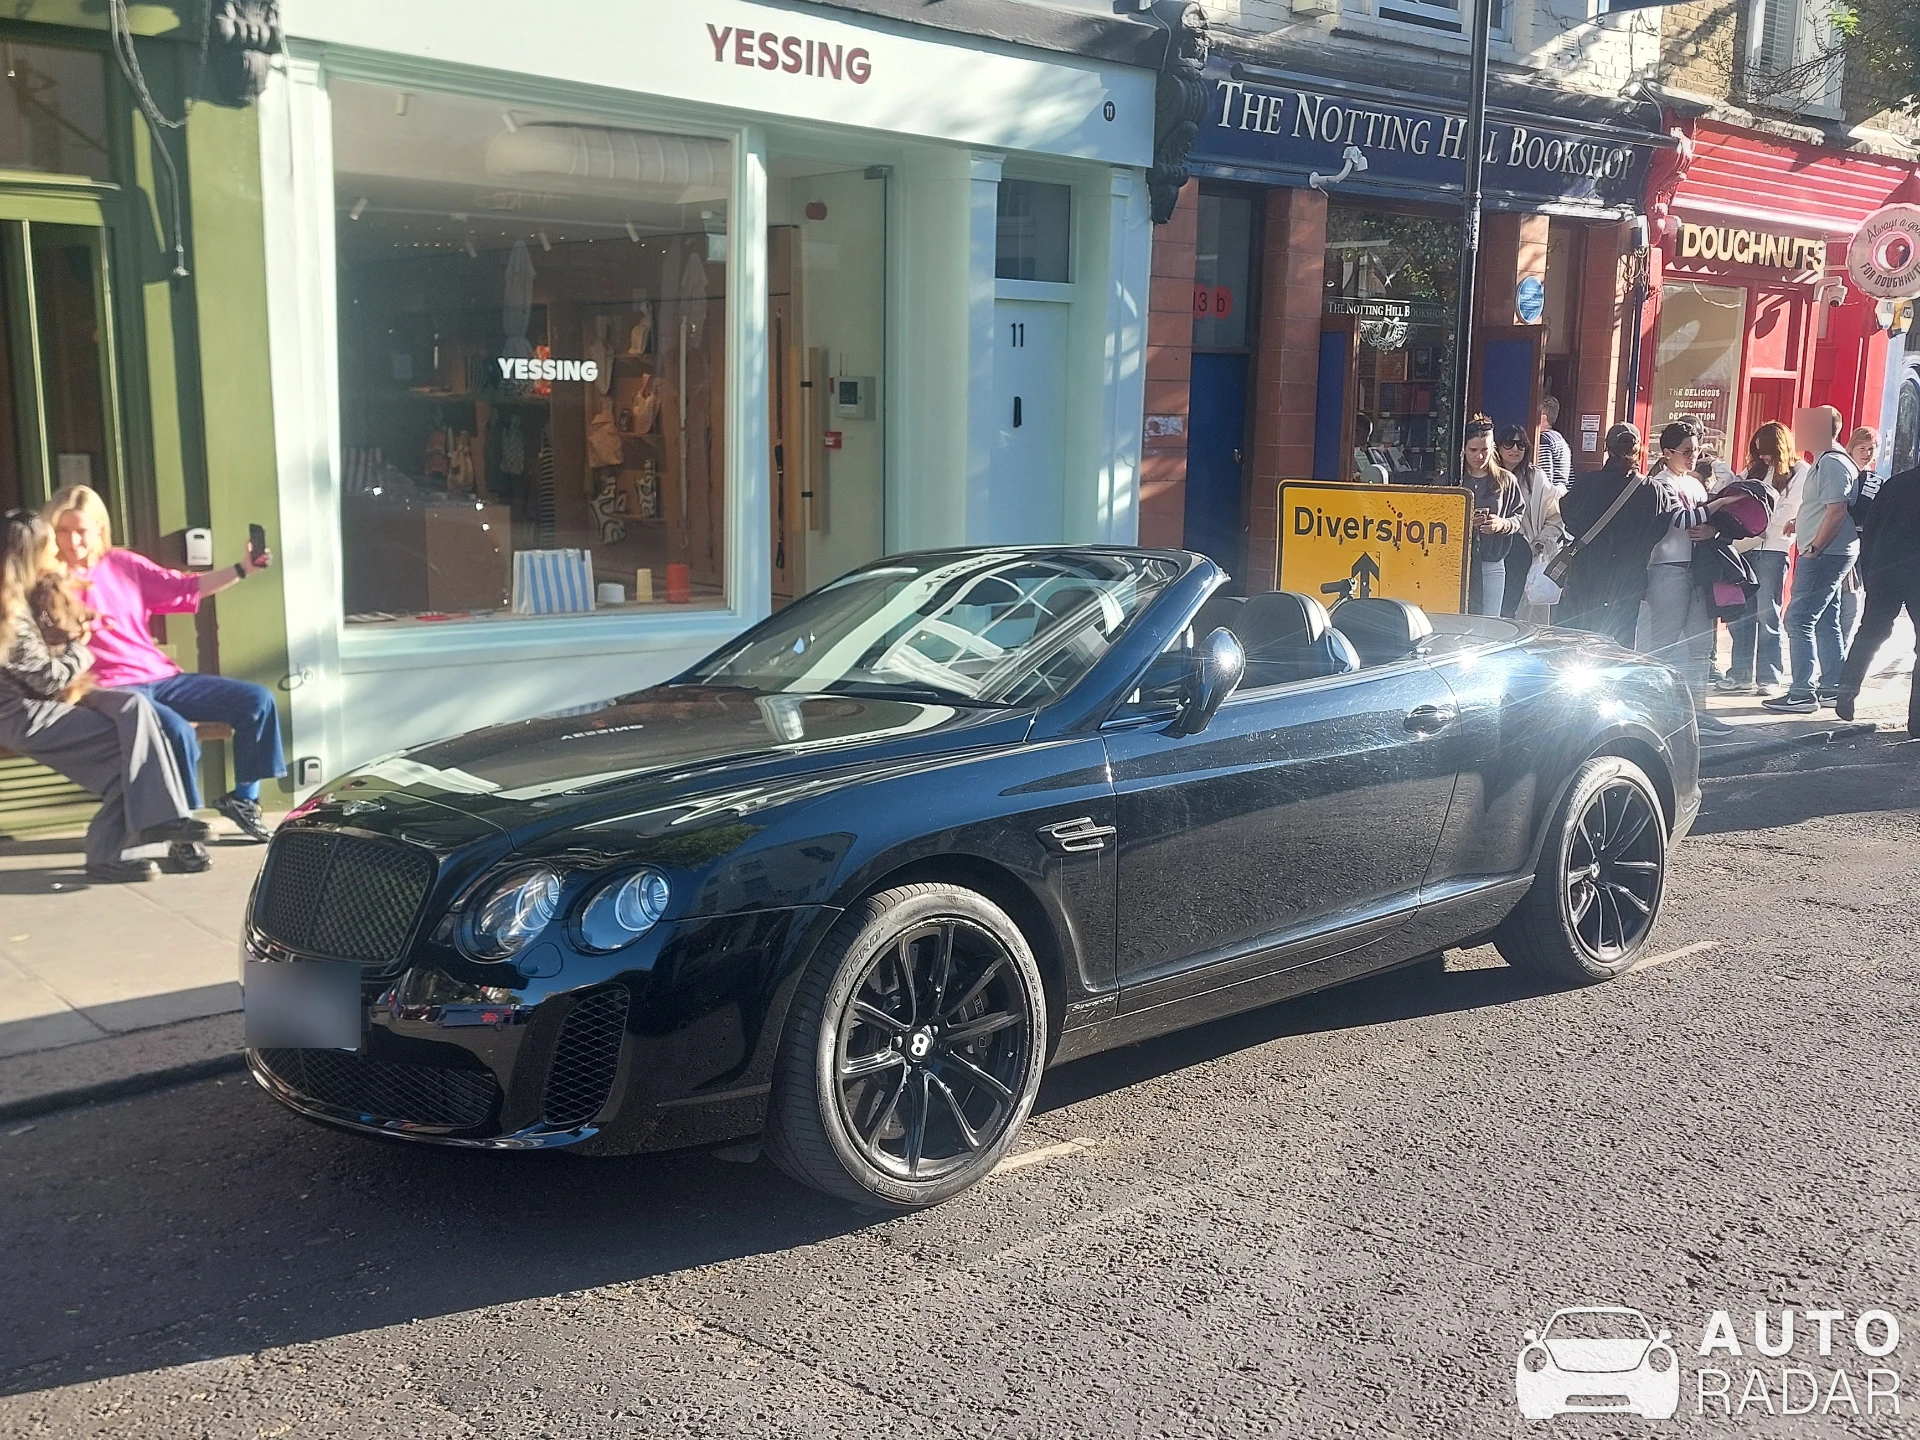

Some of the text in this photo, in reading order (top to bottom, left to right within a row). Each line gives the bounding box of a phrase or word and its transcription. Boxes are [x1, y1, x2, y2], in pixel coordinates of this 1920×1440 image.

[704, 22, 872, 85] YESSING
[1105, 105, 1113, 118] 11
[1216, 79, 1636, 181] THE NOTTING HL BOOKSHOP
[1867, 218, 1898, 245] Always
[1899, 218, 1908, 227] a
[1682, 222, 1827, 273] DOUGHNUTS
[1860, 261, 1877, 281] FOR
[1192, 290, 1226, 313] 13 b
[1327, 300, 1346, 314] THE
[1346, 301, 1385, 317] NOTTING
[1385, 303, 1404, 318] HILL
[1010, 322, 1024, 348] 11
[497, 357, 599, 382] YESSING
[1668, 388, 1721, 398] THE DELICIOUS
[1674, 400, 1713, 409] DOUGHNUT
[1294, 506, 1448, 546] Diversion
